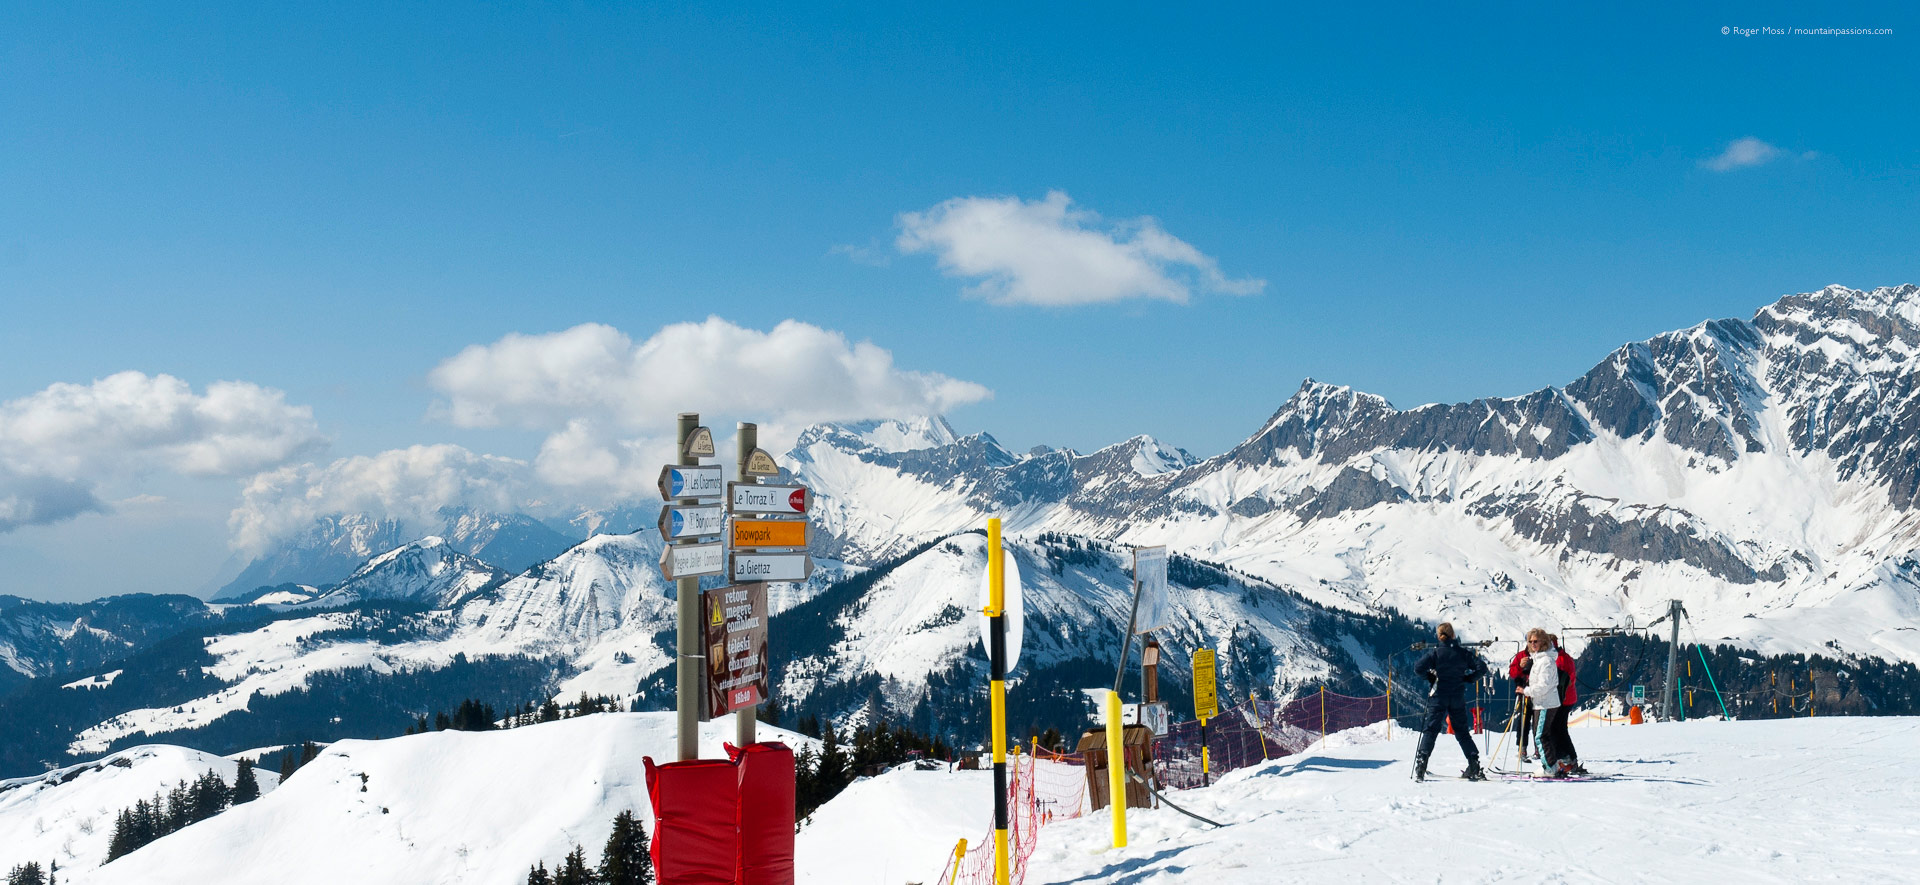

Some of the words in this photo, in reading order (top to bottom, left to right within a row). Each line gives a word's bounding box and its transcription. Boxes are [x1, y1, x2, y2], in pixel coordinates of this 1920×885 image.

[751, 461, 756, 470] La
[757, 462, 770, 471] Giettaz
[691, 474, 699, 490] Les
[700, 473, 721, 490] Charmots
[734, 490, 743, 505] Le
[745, 490, 767, 506] Torraz
[735, 525, 771, 544] Snowpark
[736, 560, 745, 575] La
[746, 559, 771, 575] Giettaz
[724, 588, 748, 604] retour
[726, 616, 760, 633] combloux
[727, 636, 751, 654] téléski
[728, 651, 759, 672] charmots
